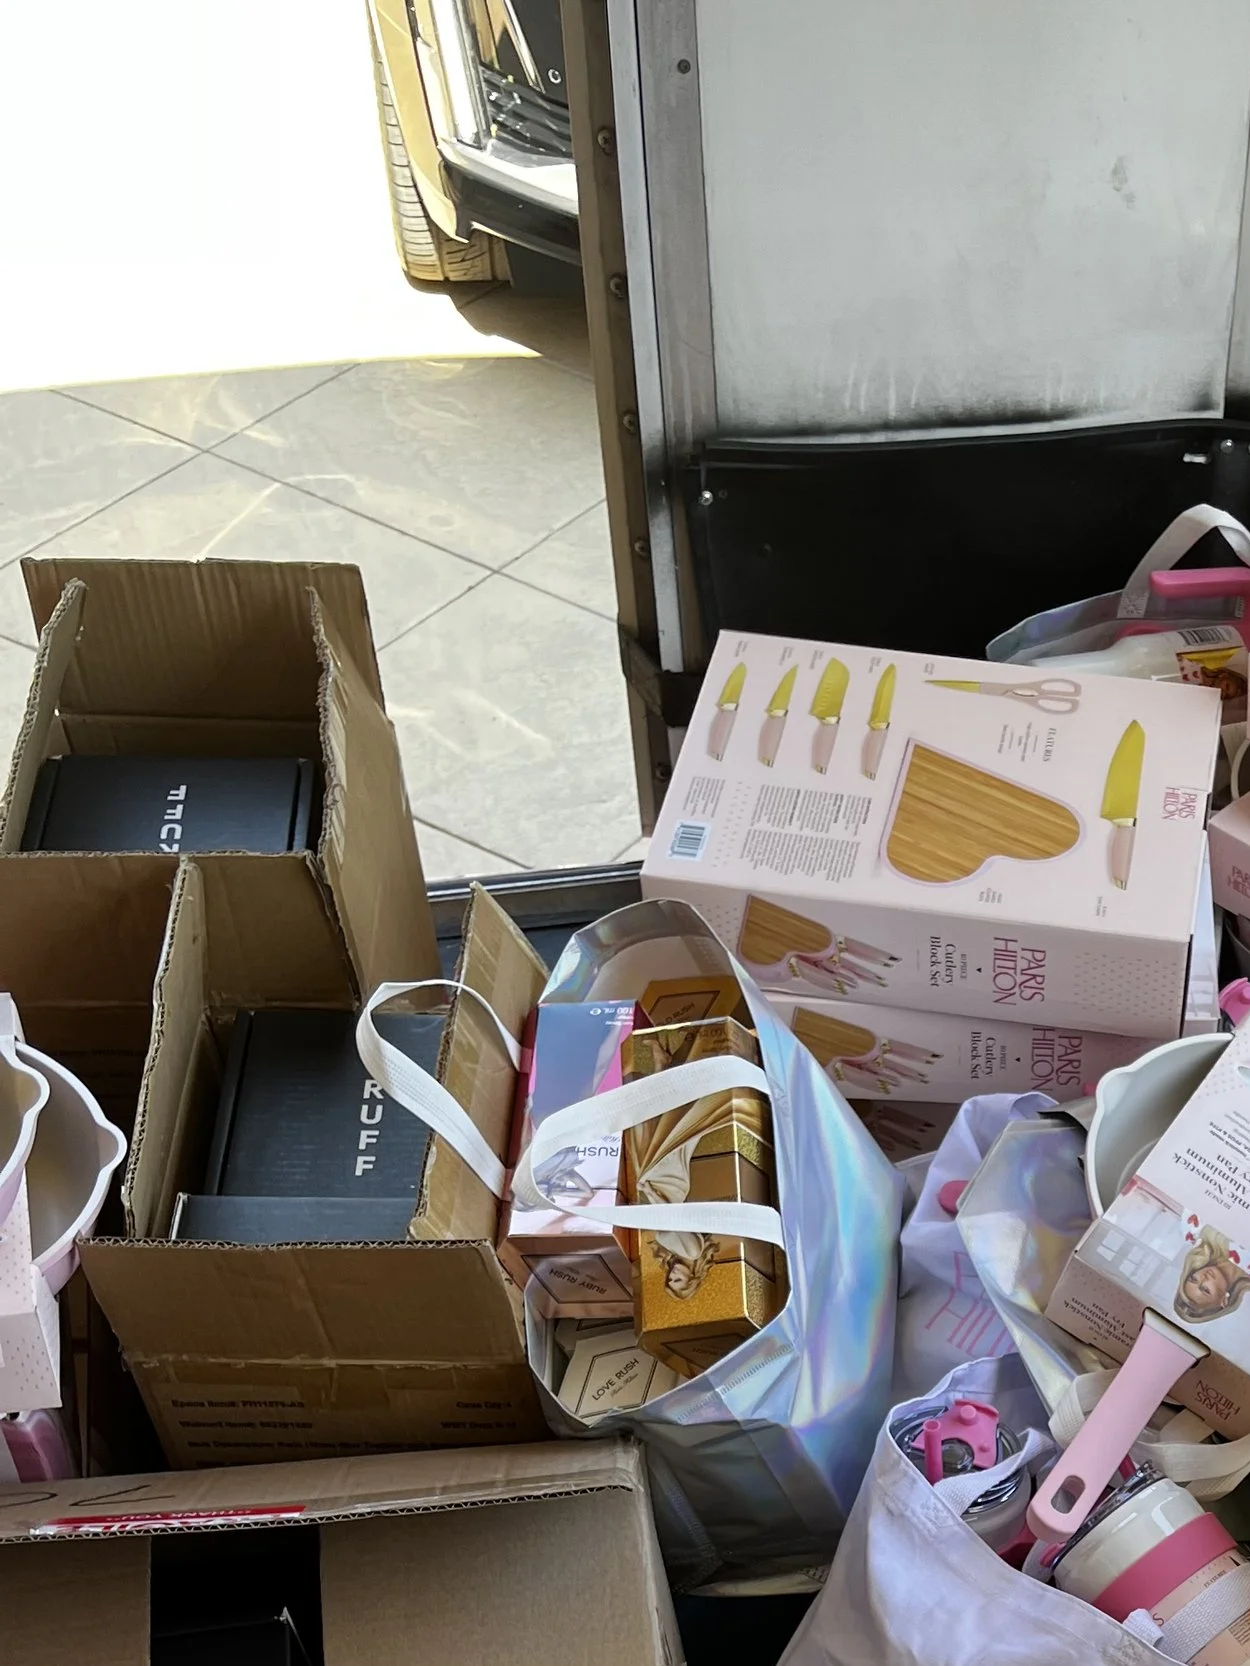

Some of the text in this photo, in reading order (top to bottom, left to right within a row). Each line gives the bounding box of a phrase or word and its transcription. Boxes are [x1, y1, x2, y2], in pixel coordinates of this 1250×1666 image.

[1162, 787, 1180, 820] HILTON
[1181, 793, 1198, 820] PARIS
[930, 935, 941, 988] Block Set
[942, 943, 957, 985] Cutlery
[992, 936, 1018, 1006] HILTON
[1019, 947, 1047, 1003] PARIS
[970, 1031, 982, 1080] Block Set
[983, 1036, 997, 1077] Cutlery
[1031, 1027, 1056, 1092] HILTON
[1056, 1035, 1084, 1086] PARIS
[355, 1079, 384, 1176] RUFF
[576, 1146, 620, 1157] RUSH
[1186, 1147, 1249, 1194] Aluminum
[1216, 1154, 1239, 1175] Pan
[1172, 1151, 1228, 1196] Nonstick
[549, 1269, 579, 1284] RUSH
[578, 1280, 608, 1295] RUBY
[592, 1358, 640, 1401] LOVE RUSH
[1195, 1380, 1241, 1416] HILTON
[1196, 1391, 1232, 1421] PARIS
